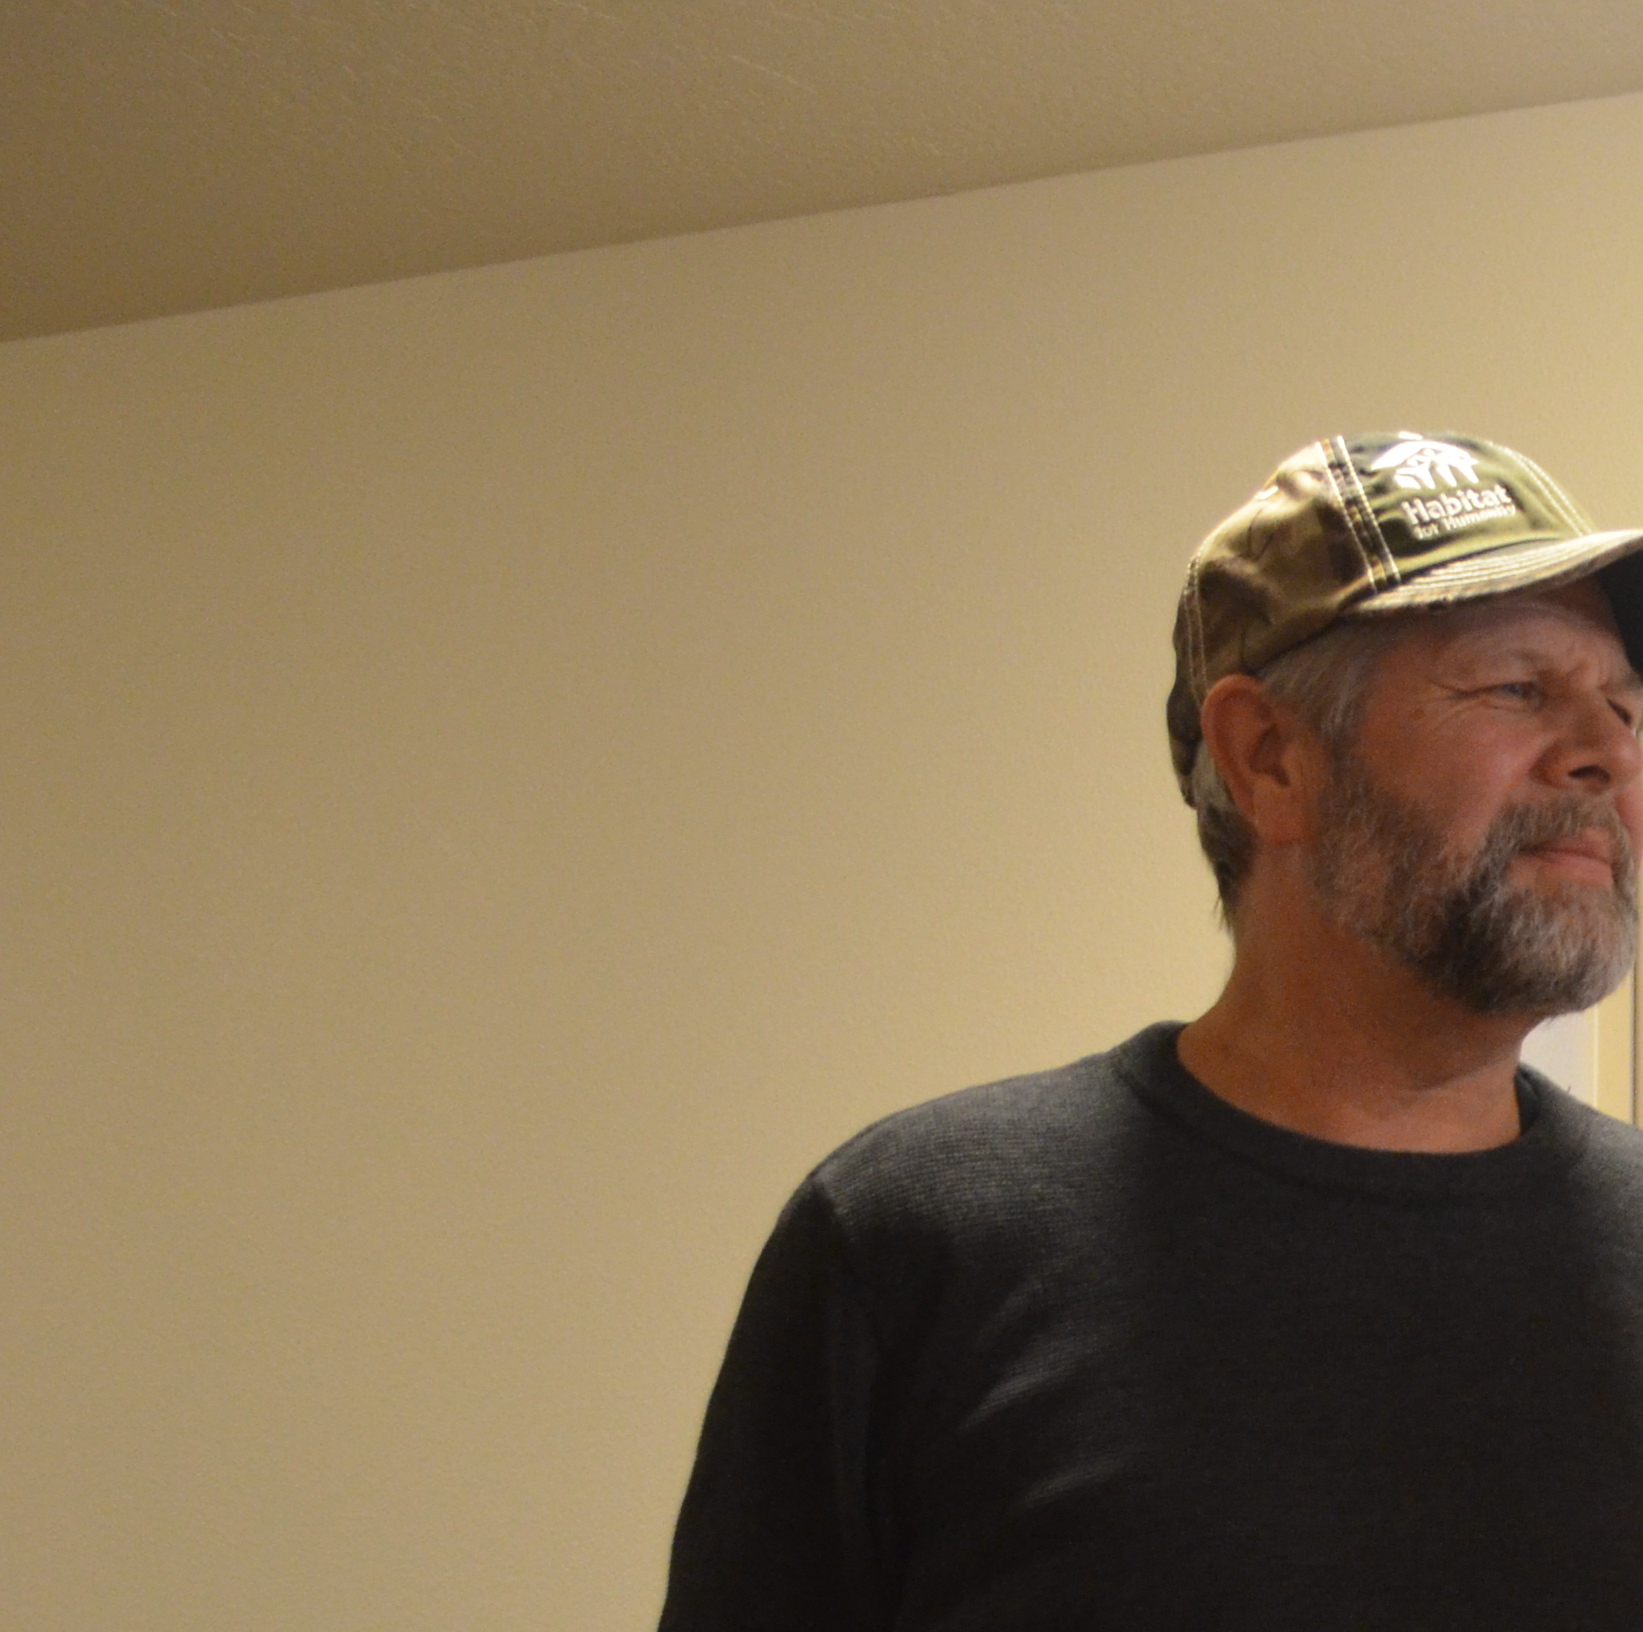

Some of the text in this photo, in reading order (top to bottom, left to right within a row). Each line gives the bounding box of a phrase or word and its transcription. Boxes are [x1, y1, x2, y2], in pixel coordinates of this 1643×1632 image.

[1401, 484, 1513, 526] Habitat
[1413, 504, 1517, 541] for Humanity
